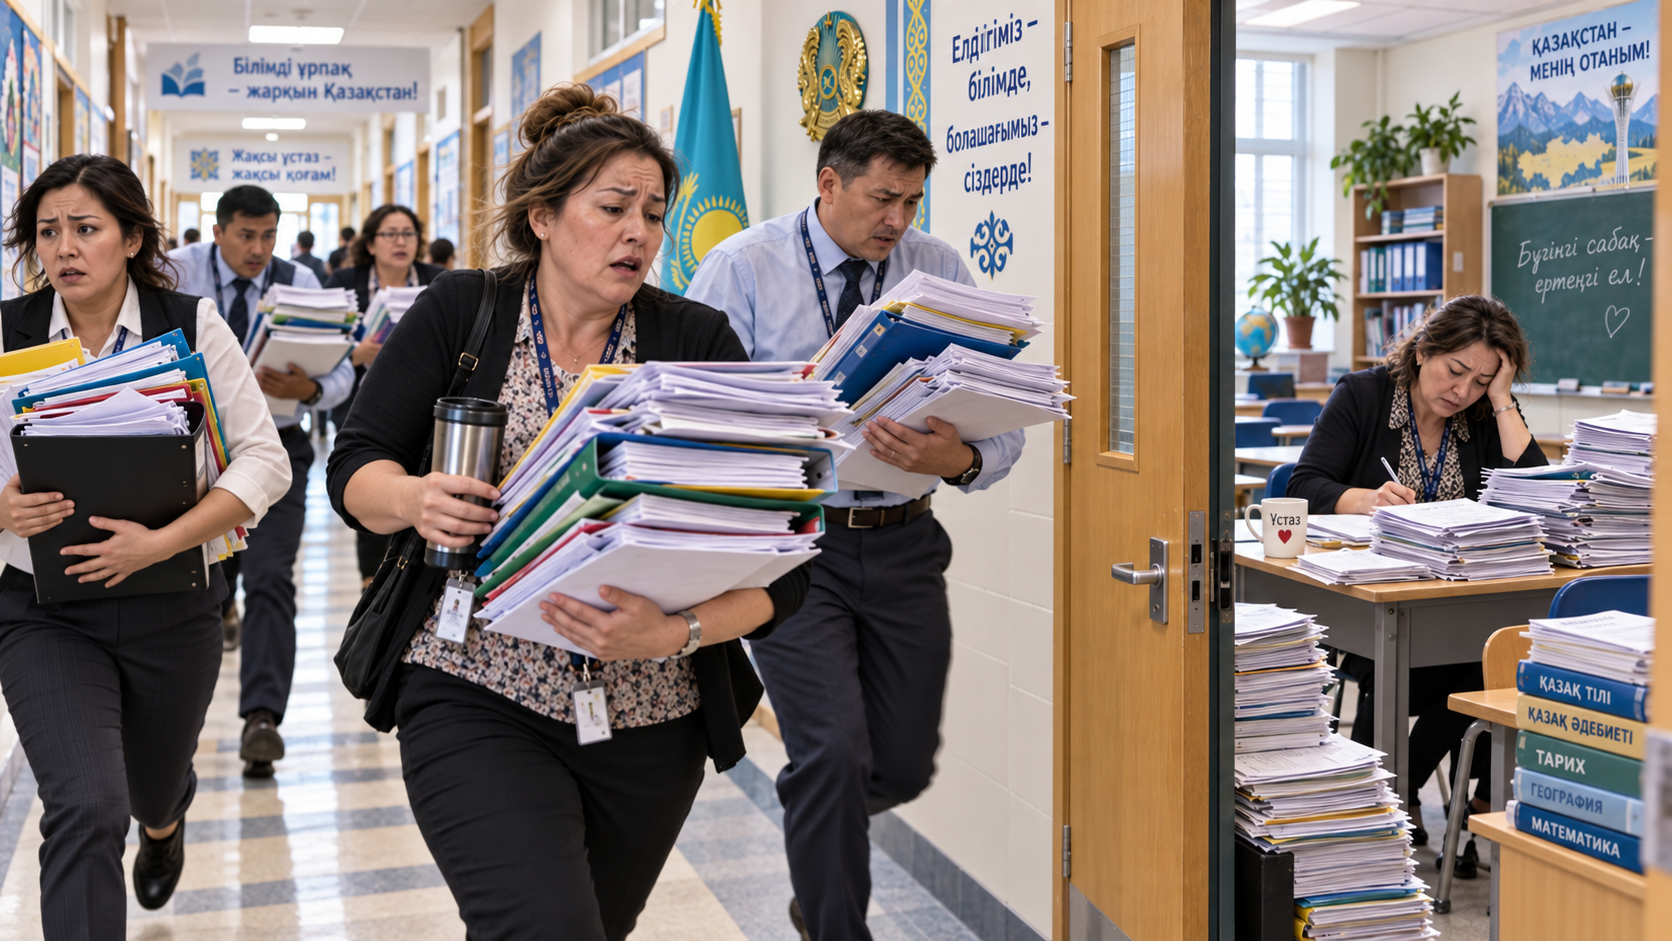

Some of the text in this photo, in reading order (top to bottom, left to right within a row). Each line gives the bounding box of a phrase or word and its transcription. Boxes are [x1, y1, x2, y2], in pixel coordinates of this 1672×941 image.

[1532, 21, 1617, 57] ҚАЗАҚСТАН
[234, 56, 352, 79] Білімді ұрпақ
[1530, 40, 1650, 82] МЕНІҢ ОТАНЫМ!
[246, 84, 317, 102] жарқын
[324, 82, 418, 102] Қазақстан!
[968, 66, 1031, 102] білімде,
[946, 114, 1038, 154] болашағымыз
[232, 149, 276, 164] Жақсы
[232, 166, 336, 182] жақсы қоғам!
[964, 152, 1032, 196] сіздерде!
[1586, 226, 1640, 254] сабақ
[1535, 267, 1598, 304] ертеңгі
[1540, 676, 1611, 705] ҚАЗАҚ ТІЛІ
[1528, 706, 1633, 745] ҚАЗАҚ ӘДЕБИЕТІ
[1536, 749, 1586, 774] ТАРИХ
[1531, 782, 1603, 814] ГЕОГРАФИЯ
[1532, 816, 1620, 858] МАТЕМАТИКА
